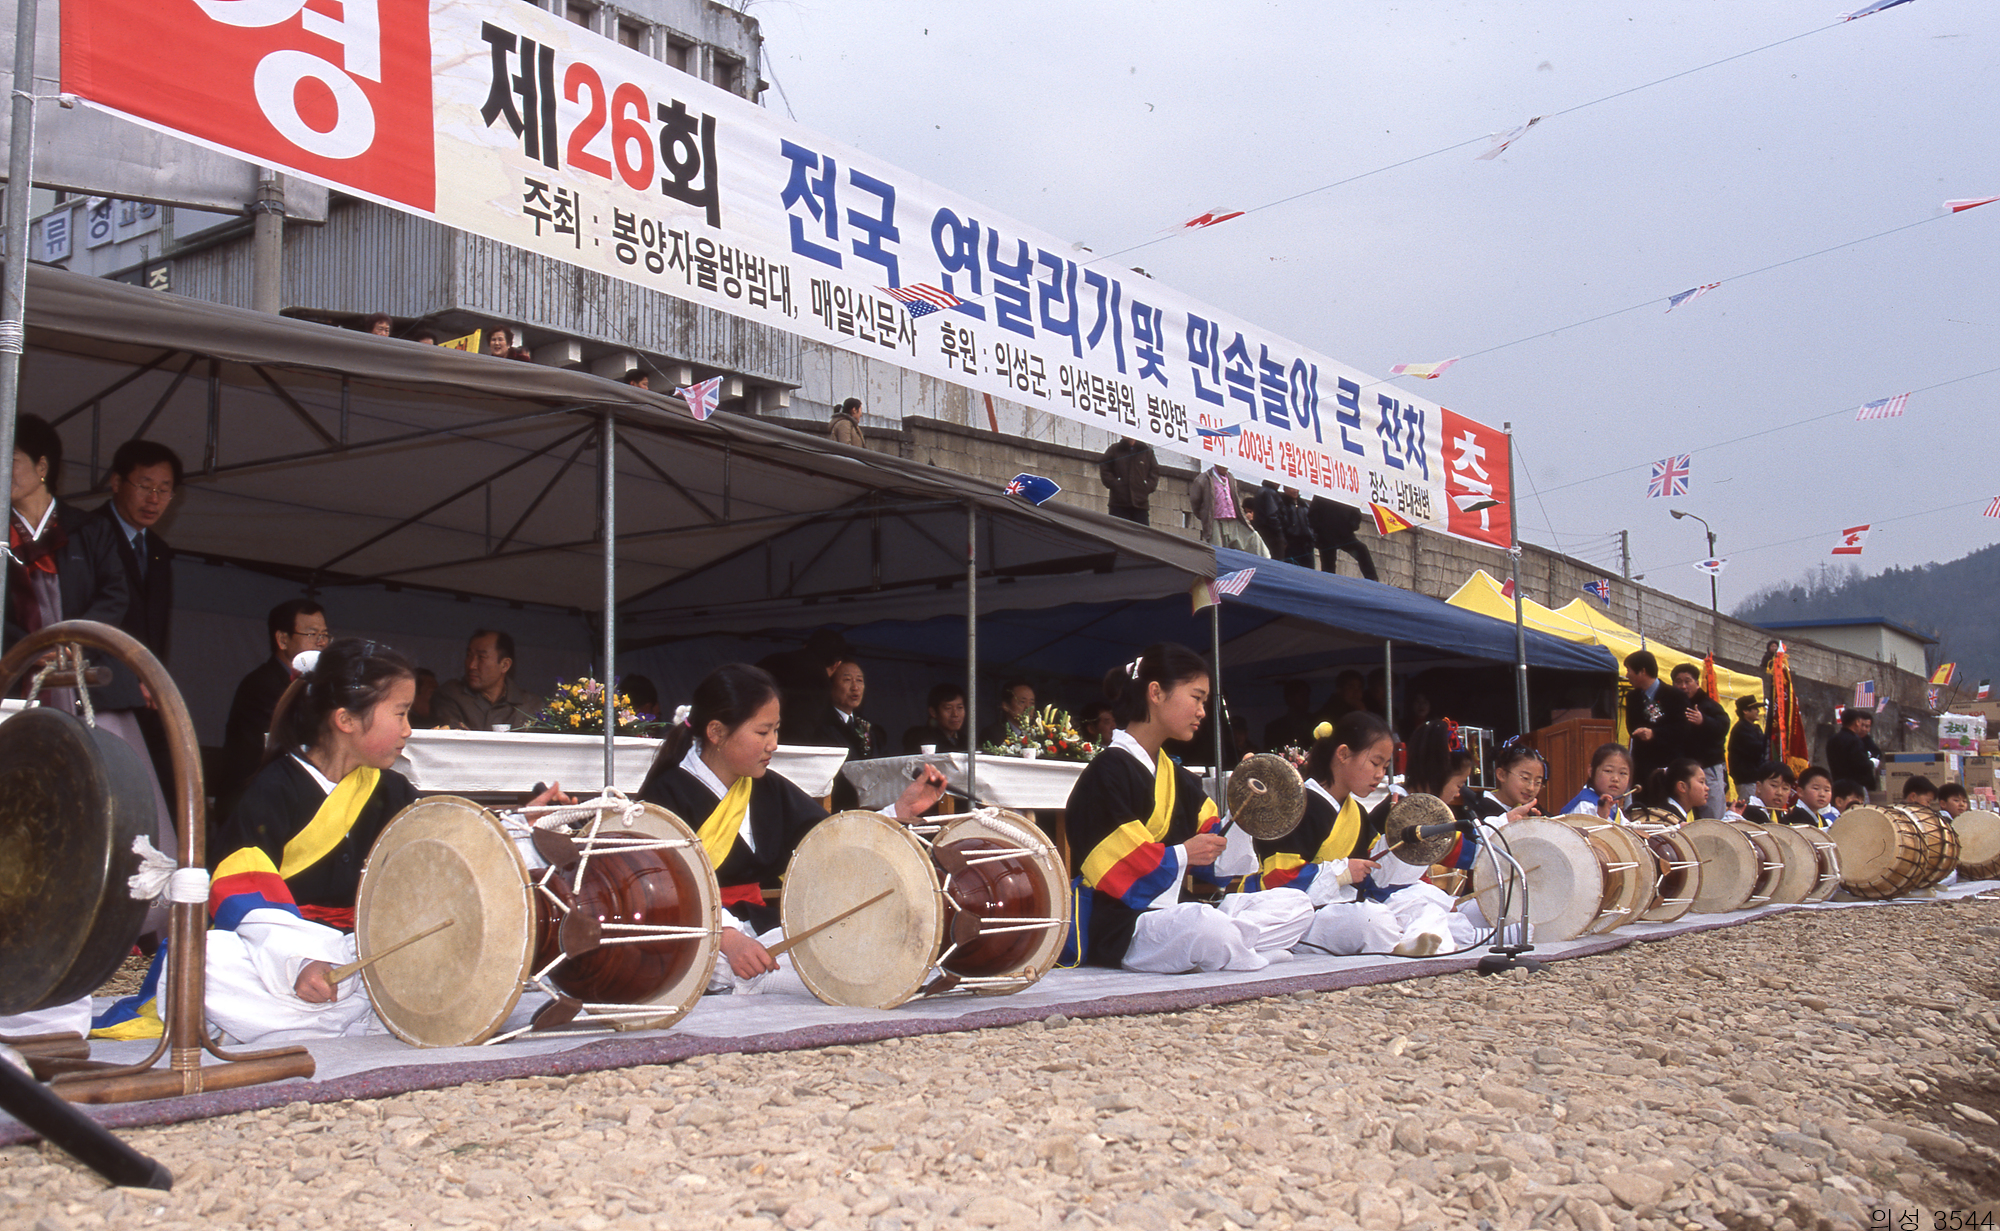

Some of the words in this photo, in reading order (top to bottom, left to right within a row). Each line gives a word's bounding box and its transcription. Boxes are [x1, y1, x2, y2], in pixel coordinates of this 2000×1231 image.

[480, 20, 721, 229] 제26회
[780, 138, 901, 288] 전국
[1186, 311, 1323, 444] 민속놀이
[1336, 375, 1365, 457] 큰
[1376, 392, 1429, 482] 잔치
[611, 206, 799, 320] 봉양자율방범대,
[810, 278, 918, 357] 매일신문사
[995, 342, 1052, 400] 의성군,
[1059, 364, 1141, 429] 의성문화원,
[1146, 392, 1189, 443] 봉양면
[1238, 428, 1276, 472] 2003년
